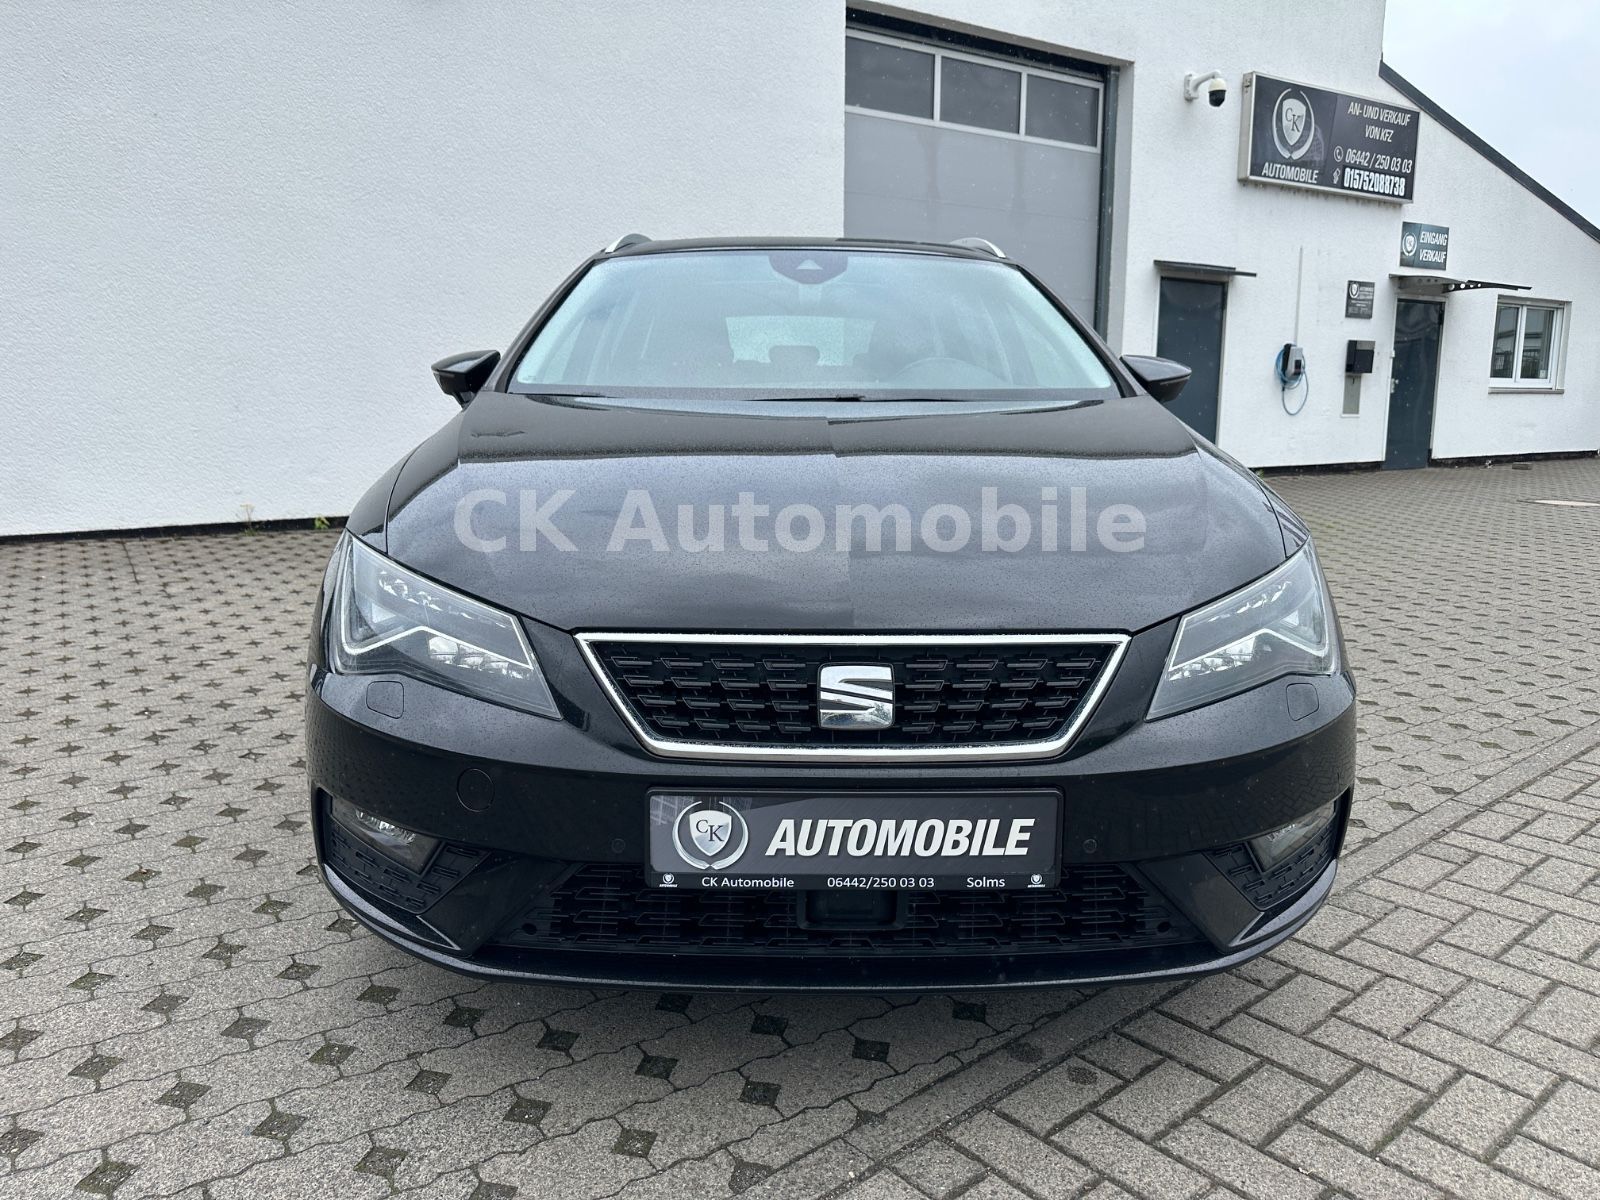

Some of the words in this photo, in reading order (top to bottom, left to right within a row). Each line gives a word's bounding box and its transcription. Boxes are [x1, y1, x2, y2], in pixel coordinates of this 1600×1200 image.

[1347, 101, 1362, 116] AN-
[1362, 104, 1379, 120] UND
[1379, 108, 1411, 126] VERKAUF
[1365, 124, 1380, 140] VON
[1380, 127, 1394, 142] KFZ
[1345, 148, 1370, 166] 06442
[1375, 154, 1391, 170] 250
[1390, 157, 1402, 172] 03
[1401, 159, 1413, 174] 03
[1262, 162, 1319, 184] AUTOMOBILE
[1343, 167, 1406, 196] 015752088738
[1420, 231, 1448, 246] EINGANG
[1419, 249, 1447, 263] VERKAUF
[764, 817, 1036, 857] AUTOMOBILE
[701, 877, 718, 888] CK
[721, 877, 795, 888] Automobile
[827, 877, 897, 889] 06442/250
[900, 877, 916, 888] 03
[919, 877, 935, 888] 03
[966, 876, 1006, 888] Solms
